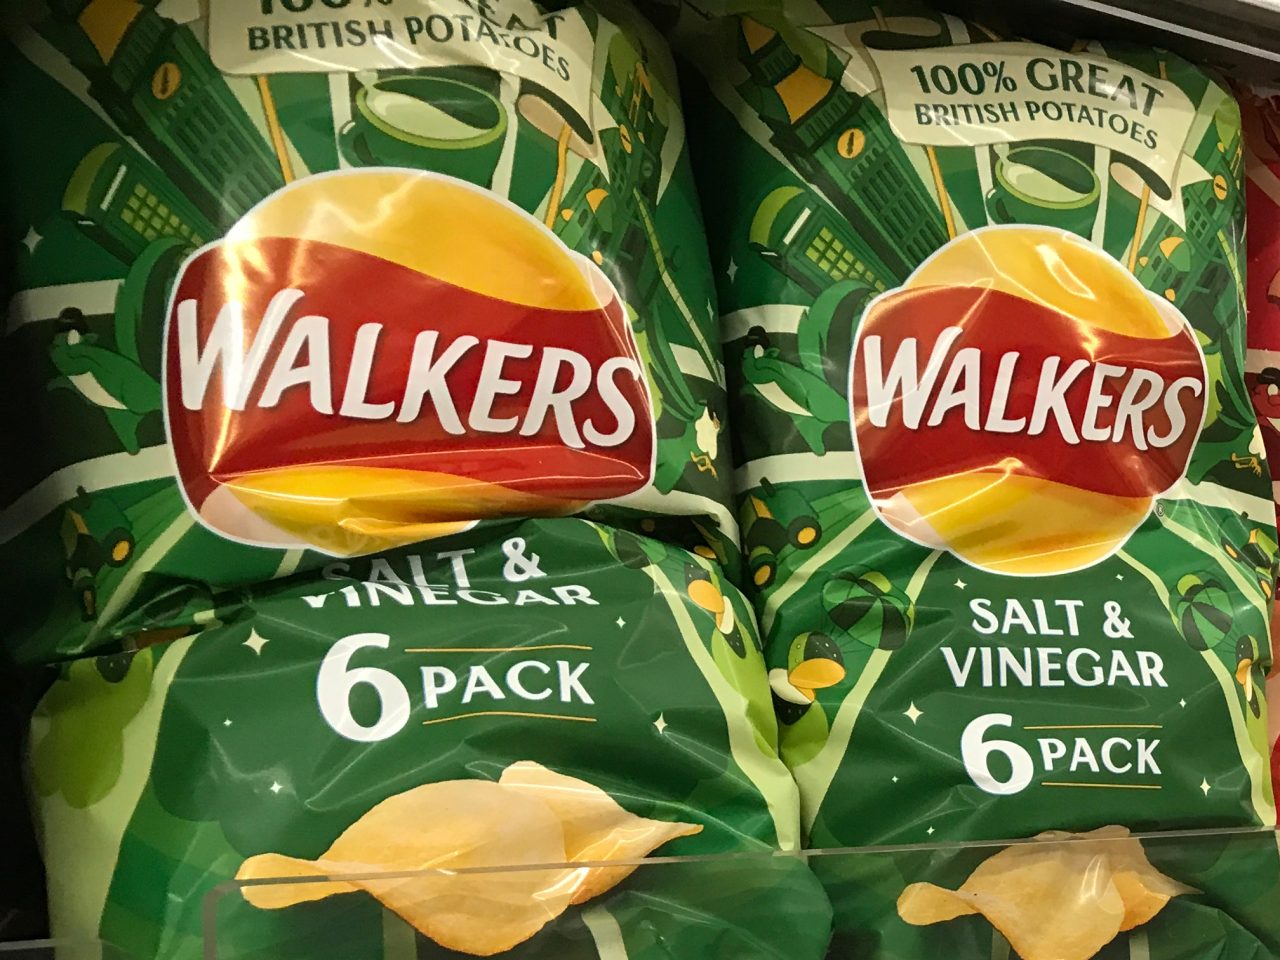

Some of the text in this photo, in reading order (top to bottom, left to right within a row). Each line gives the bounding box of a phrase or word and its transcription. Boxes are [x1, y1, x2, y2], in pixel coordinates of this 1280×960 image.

[247, 14, 571, 82] BRITISH POTATOES
[910, 57, 1164, 118] 100% GREAT
[915, 100, 1158, 151] BRITISH POTATOES
[177, 288, 641, 450] WALKERS
[863, 327, 1201, 451] WALKERS
[502, 537, 547, 582] &
[302, 581, 600, 608] VINEGAR
[969, 598, 1135, 638] SALT &
[316, 632, 595, 742] 6 PACK
[940, 646, 1168, 688] VINEGAR
[960, 713, 1162, 796] 6 PACK
